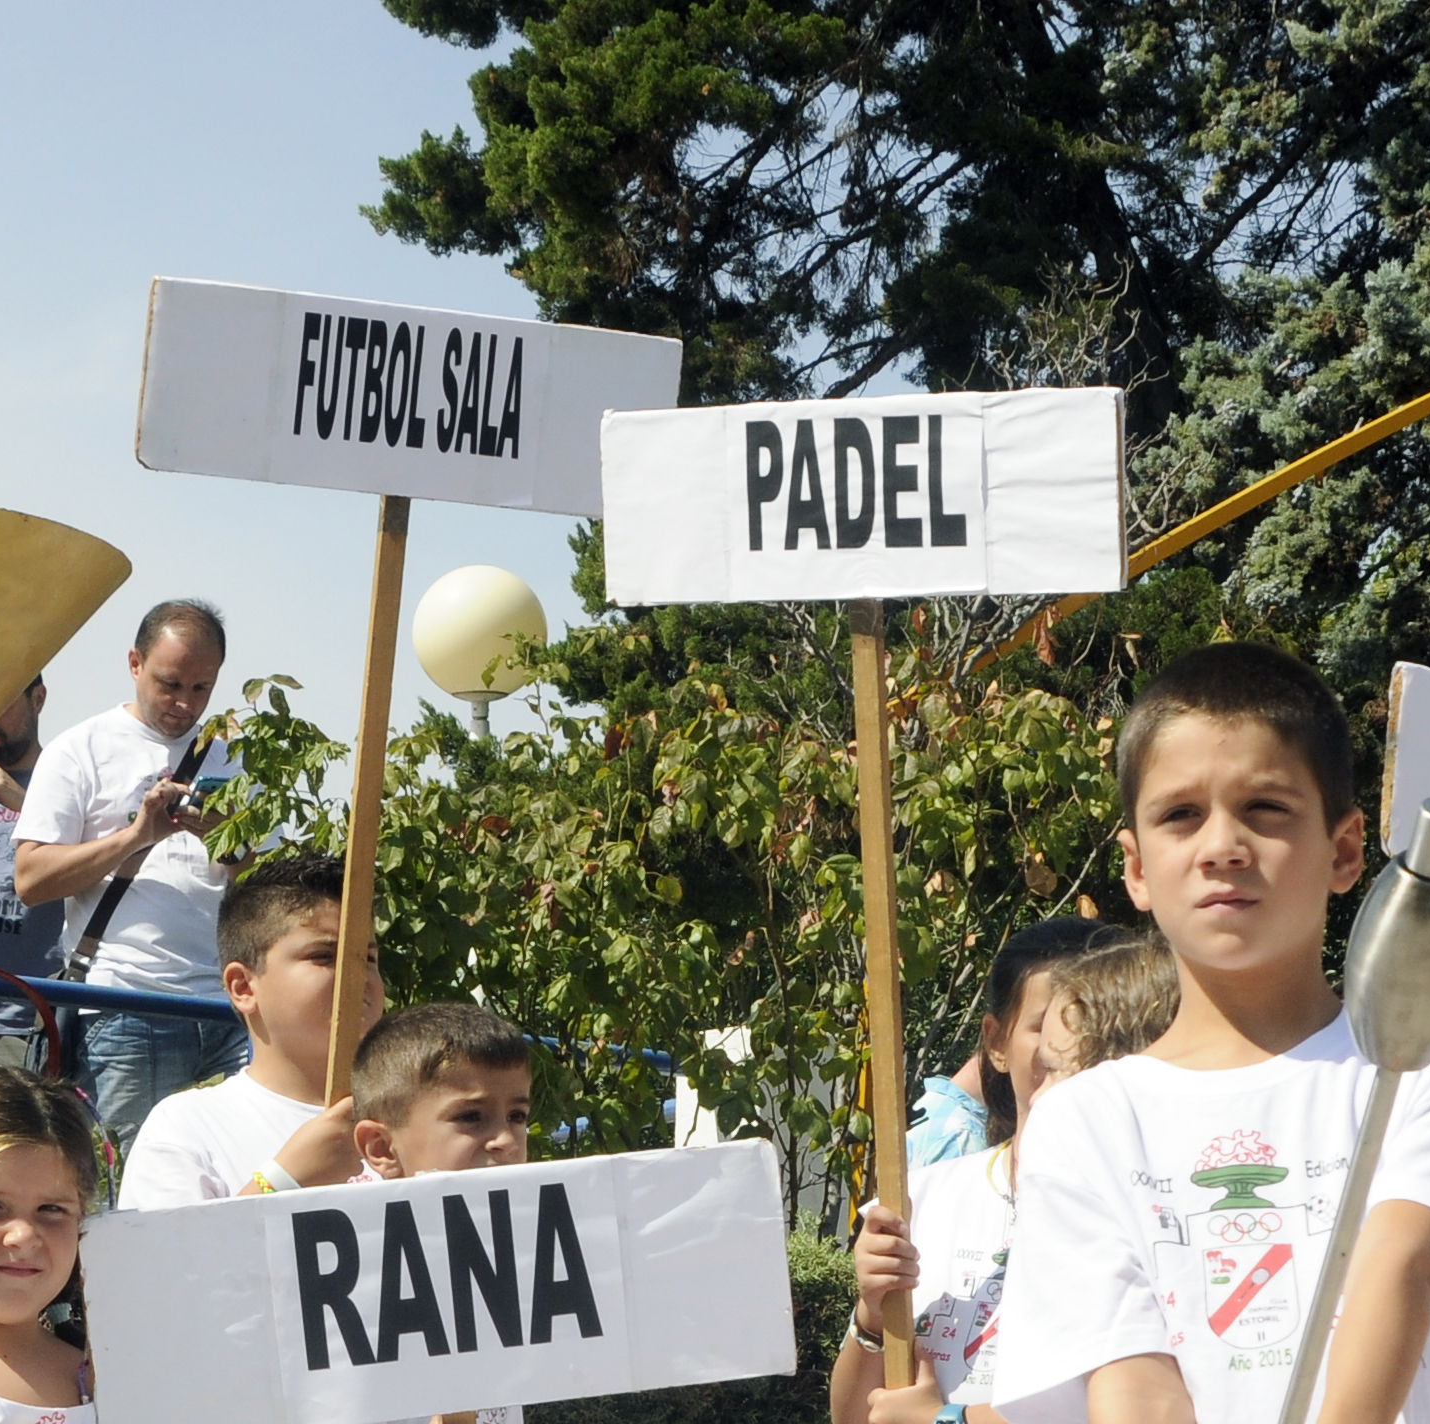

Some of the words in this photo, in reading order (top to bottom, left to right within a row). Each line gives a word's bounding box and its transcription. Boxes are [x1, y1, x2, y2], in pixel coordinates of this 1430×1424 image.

[293, 311, 427, 449] FUTBOL
[437, 327, 522, 460] SALA
[746, 414, 967, 551] PADEL
[291, 1182, 604, 1371] RANA
[942, 1326, 957, 1339] 24
[1228, 1353, 1252, 1371] Año
[1259, 1348, 1293, 1368] 2015
